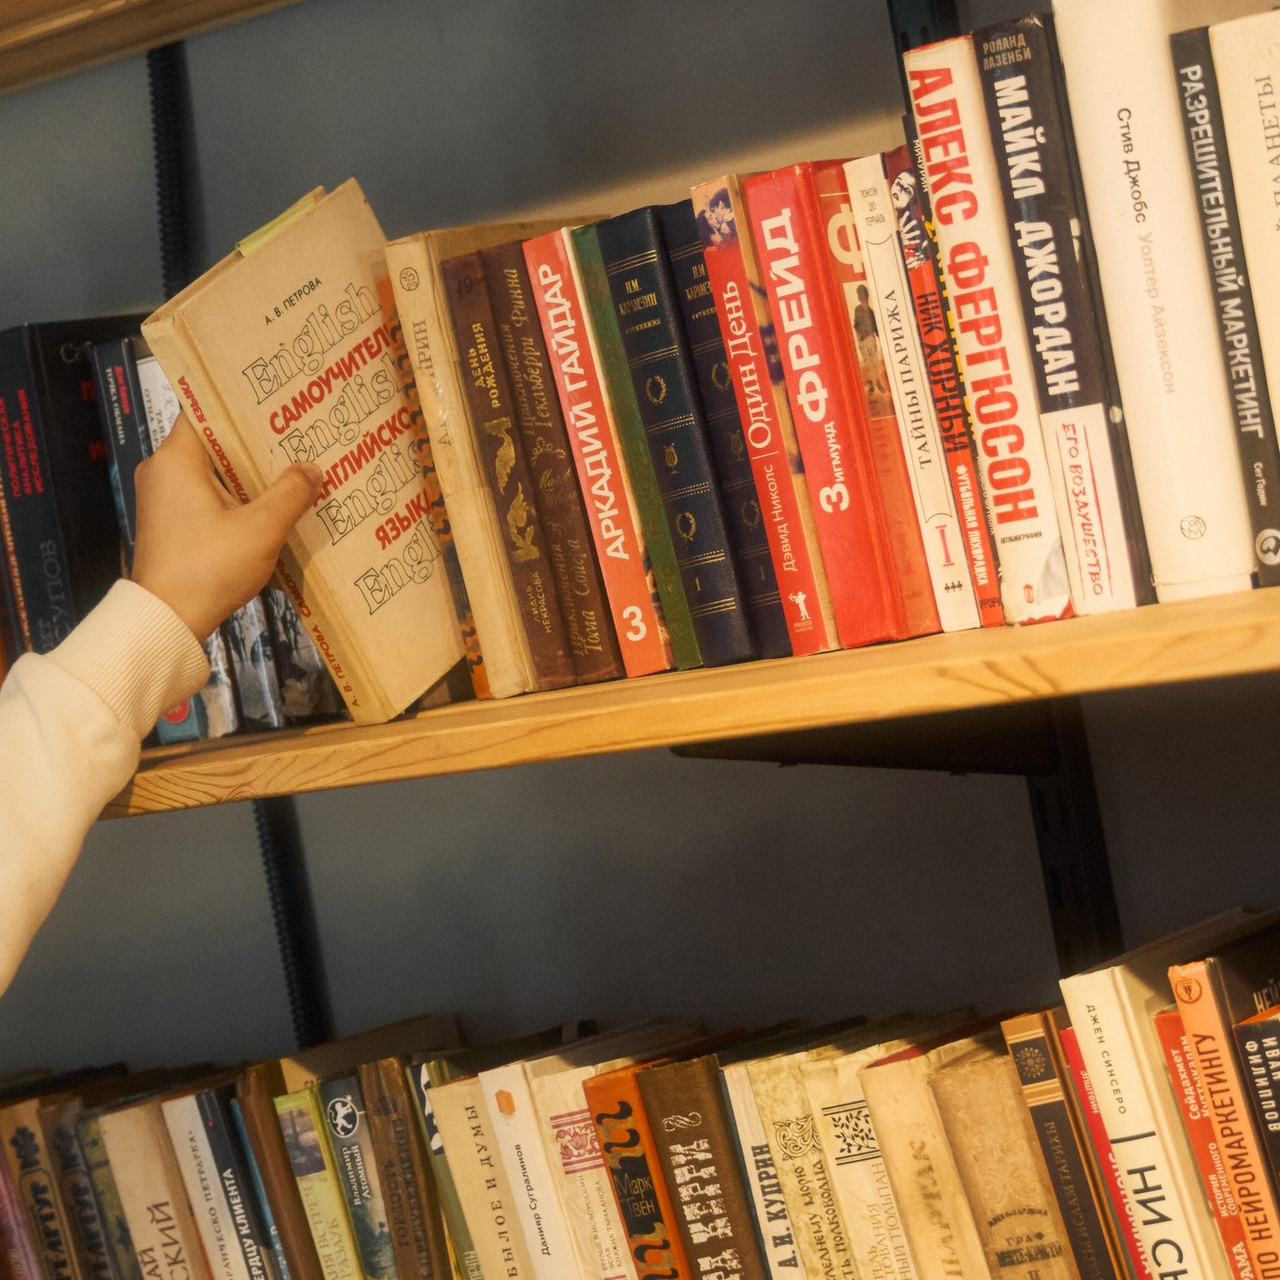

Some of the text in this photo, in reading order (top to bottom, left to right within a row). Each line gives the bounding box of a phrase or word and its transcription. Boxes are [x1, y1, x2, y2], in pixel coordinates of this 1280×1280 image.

[982, 33, 1026, 55] РОЛАНД
[1116, 107, 1134, 157] Стив
[1121, 158, 1147, 225] Джобс
[993, 76, 1081, 397] МАЙКЛ ДЖОРДАН
[1178, 64, 1265, 440] РАЗРЕШИТЕЛЬНЫЙ МАРКЕТИНГ
[264, 276, 323, 327] А. В. ПЕТРОВА
[908, 68, 1040, 527] АЛЕКС ФЕРГЮСОН
[916, 292, 938, 335] НИК
[242, 281, 383, 406] English
[471, 322, 501, 408] РОЖДЕНИЯ
[760, 207, 851, 515] Зигмунд ФРЕЙД
[883, 287, 932, 470] ТАЙНЫ ПАРИЖА
[177, 375, 208, 423] ЯЗЫКА
[539, 264, 631, 560] АРКАДИЙ ГАЙДАР
[722, 280, 798, 572] Дэвид Николс Один День
[312, 406, 414, 508] АНГЛИЙСКО
[955, 464, 990, 587] ФУТБОЛЬНАЯ ЛИХОРАДКА
[1060, 422, 1104, 597] ЕГО ВОЗДУШЕСТВО
[529, 570, 553, 634] НЕКРАСОВА
[622, 605, 647, 641] 3
[312, 624, 345, 679] ПЕТРОВА
[1085, 1003, 1128, 1116] ДЖЕН СИНСЕРО
[1171, 1034, 1200, 1120] Сейдахмет
[1262, 1036, 1278, 1079] ИВАН
[464, 1102, 493, 1172] ДУМЫ
[1191, 1031, 1272, 1255] НЕЙРОМАРКЕТИНГУ
[219, 1165, 251, 1237] КЛИЕНТА
[340, 1145, 362, 1206] Владимир
[512, 1142, 537, 1211] Сугралинов
[616, 1169, 654, 1198] Марк
[751, 1141, 798, 1272] А. И. КУПРИН
[868, 1160, 903, 1243] ТЮЛЬПАН
[1126, 1160, 1174, 1223] НИ
[1209, 1141, 1236, 1216] СОВРЕМЕННОГО
[1209, 1172, 1229, 1218] ИСТОРИЯ
[488, 1197, 520, 1280] БЫЛОЕ
[532, 1211, 550, 1257] Данияр
